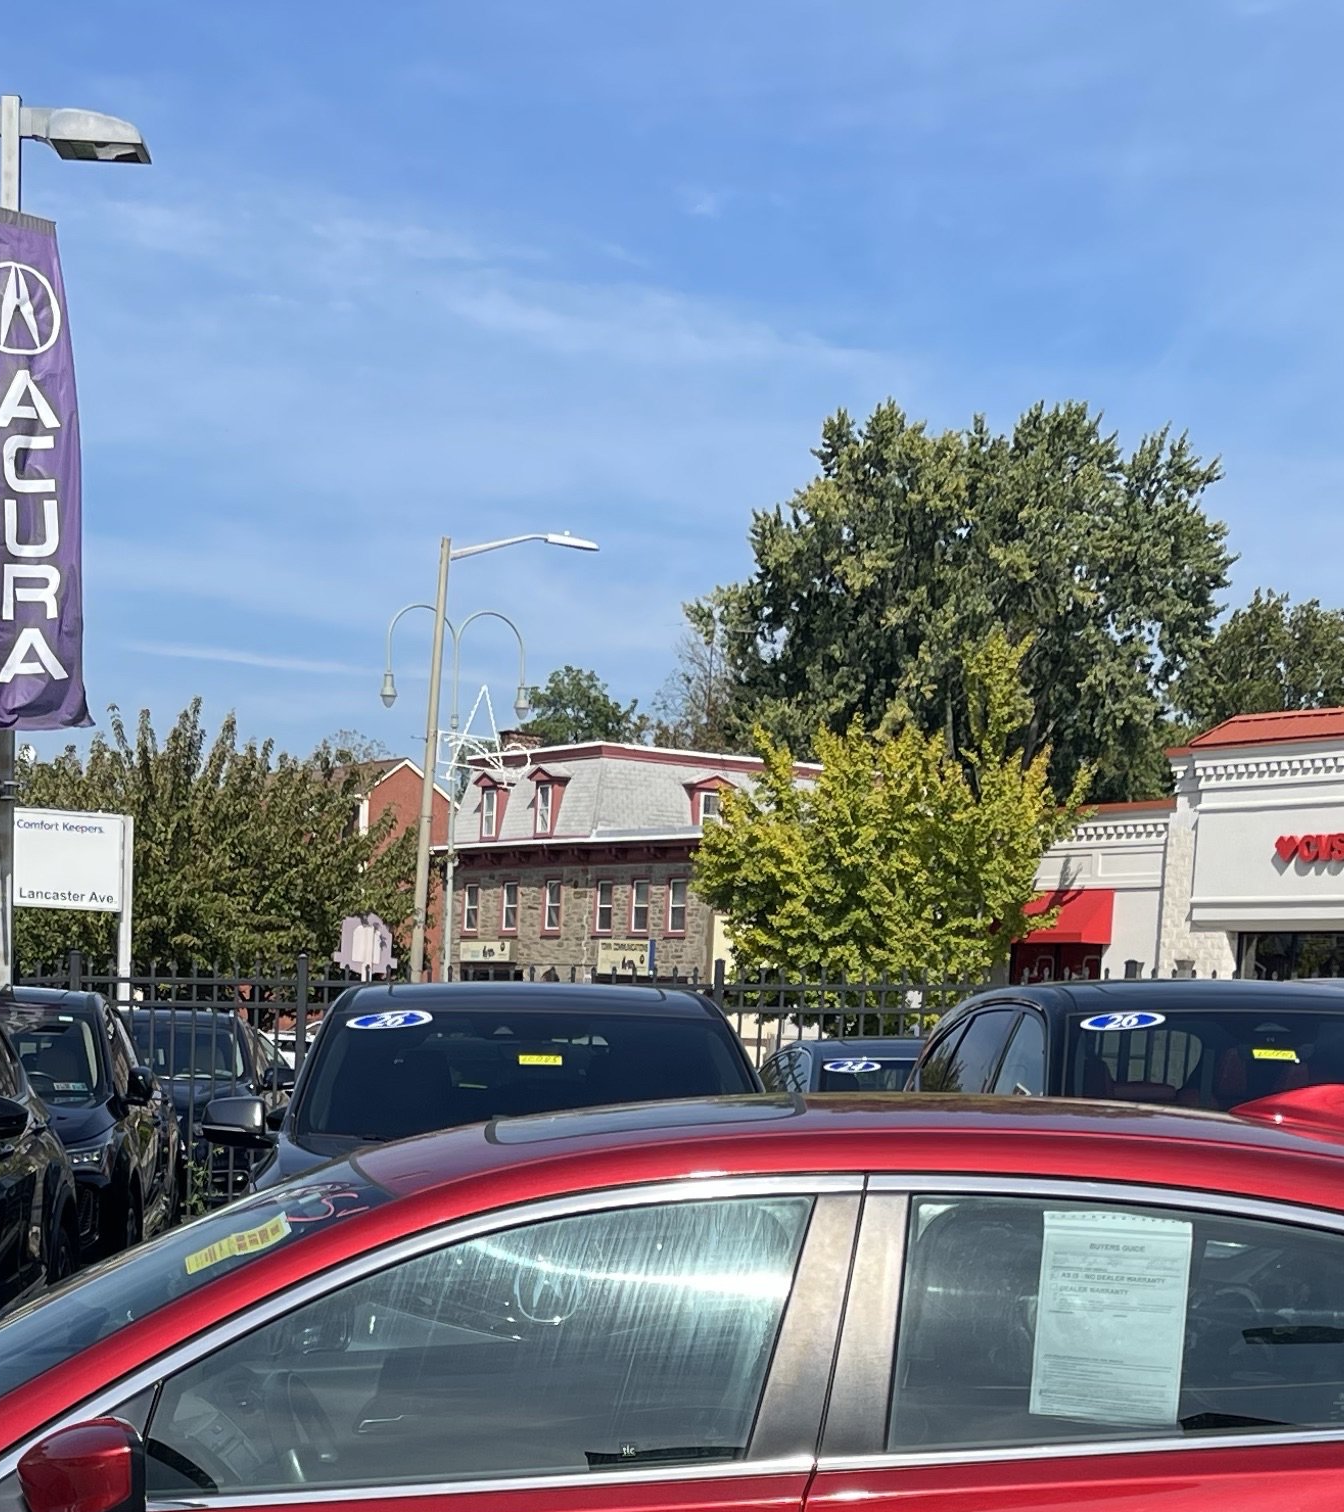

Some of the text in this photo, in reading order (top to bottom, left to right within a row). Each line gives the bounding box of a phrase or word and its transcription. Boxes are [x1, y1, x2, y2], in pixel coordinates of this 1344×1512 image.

[16, 819, 59, 831] Comfort
[19, 887, 85, 903] Lancaster
[1105, 1014, 1139, 1029] 26
